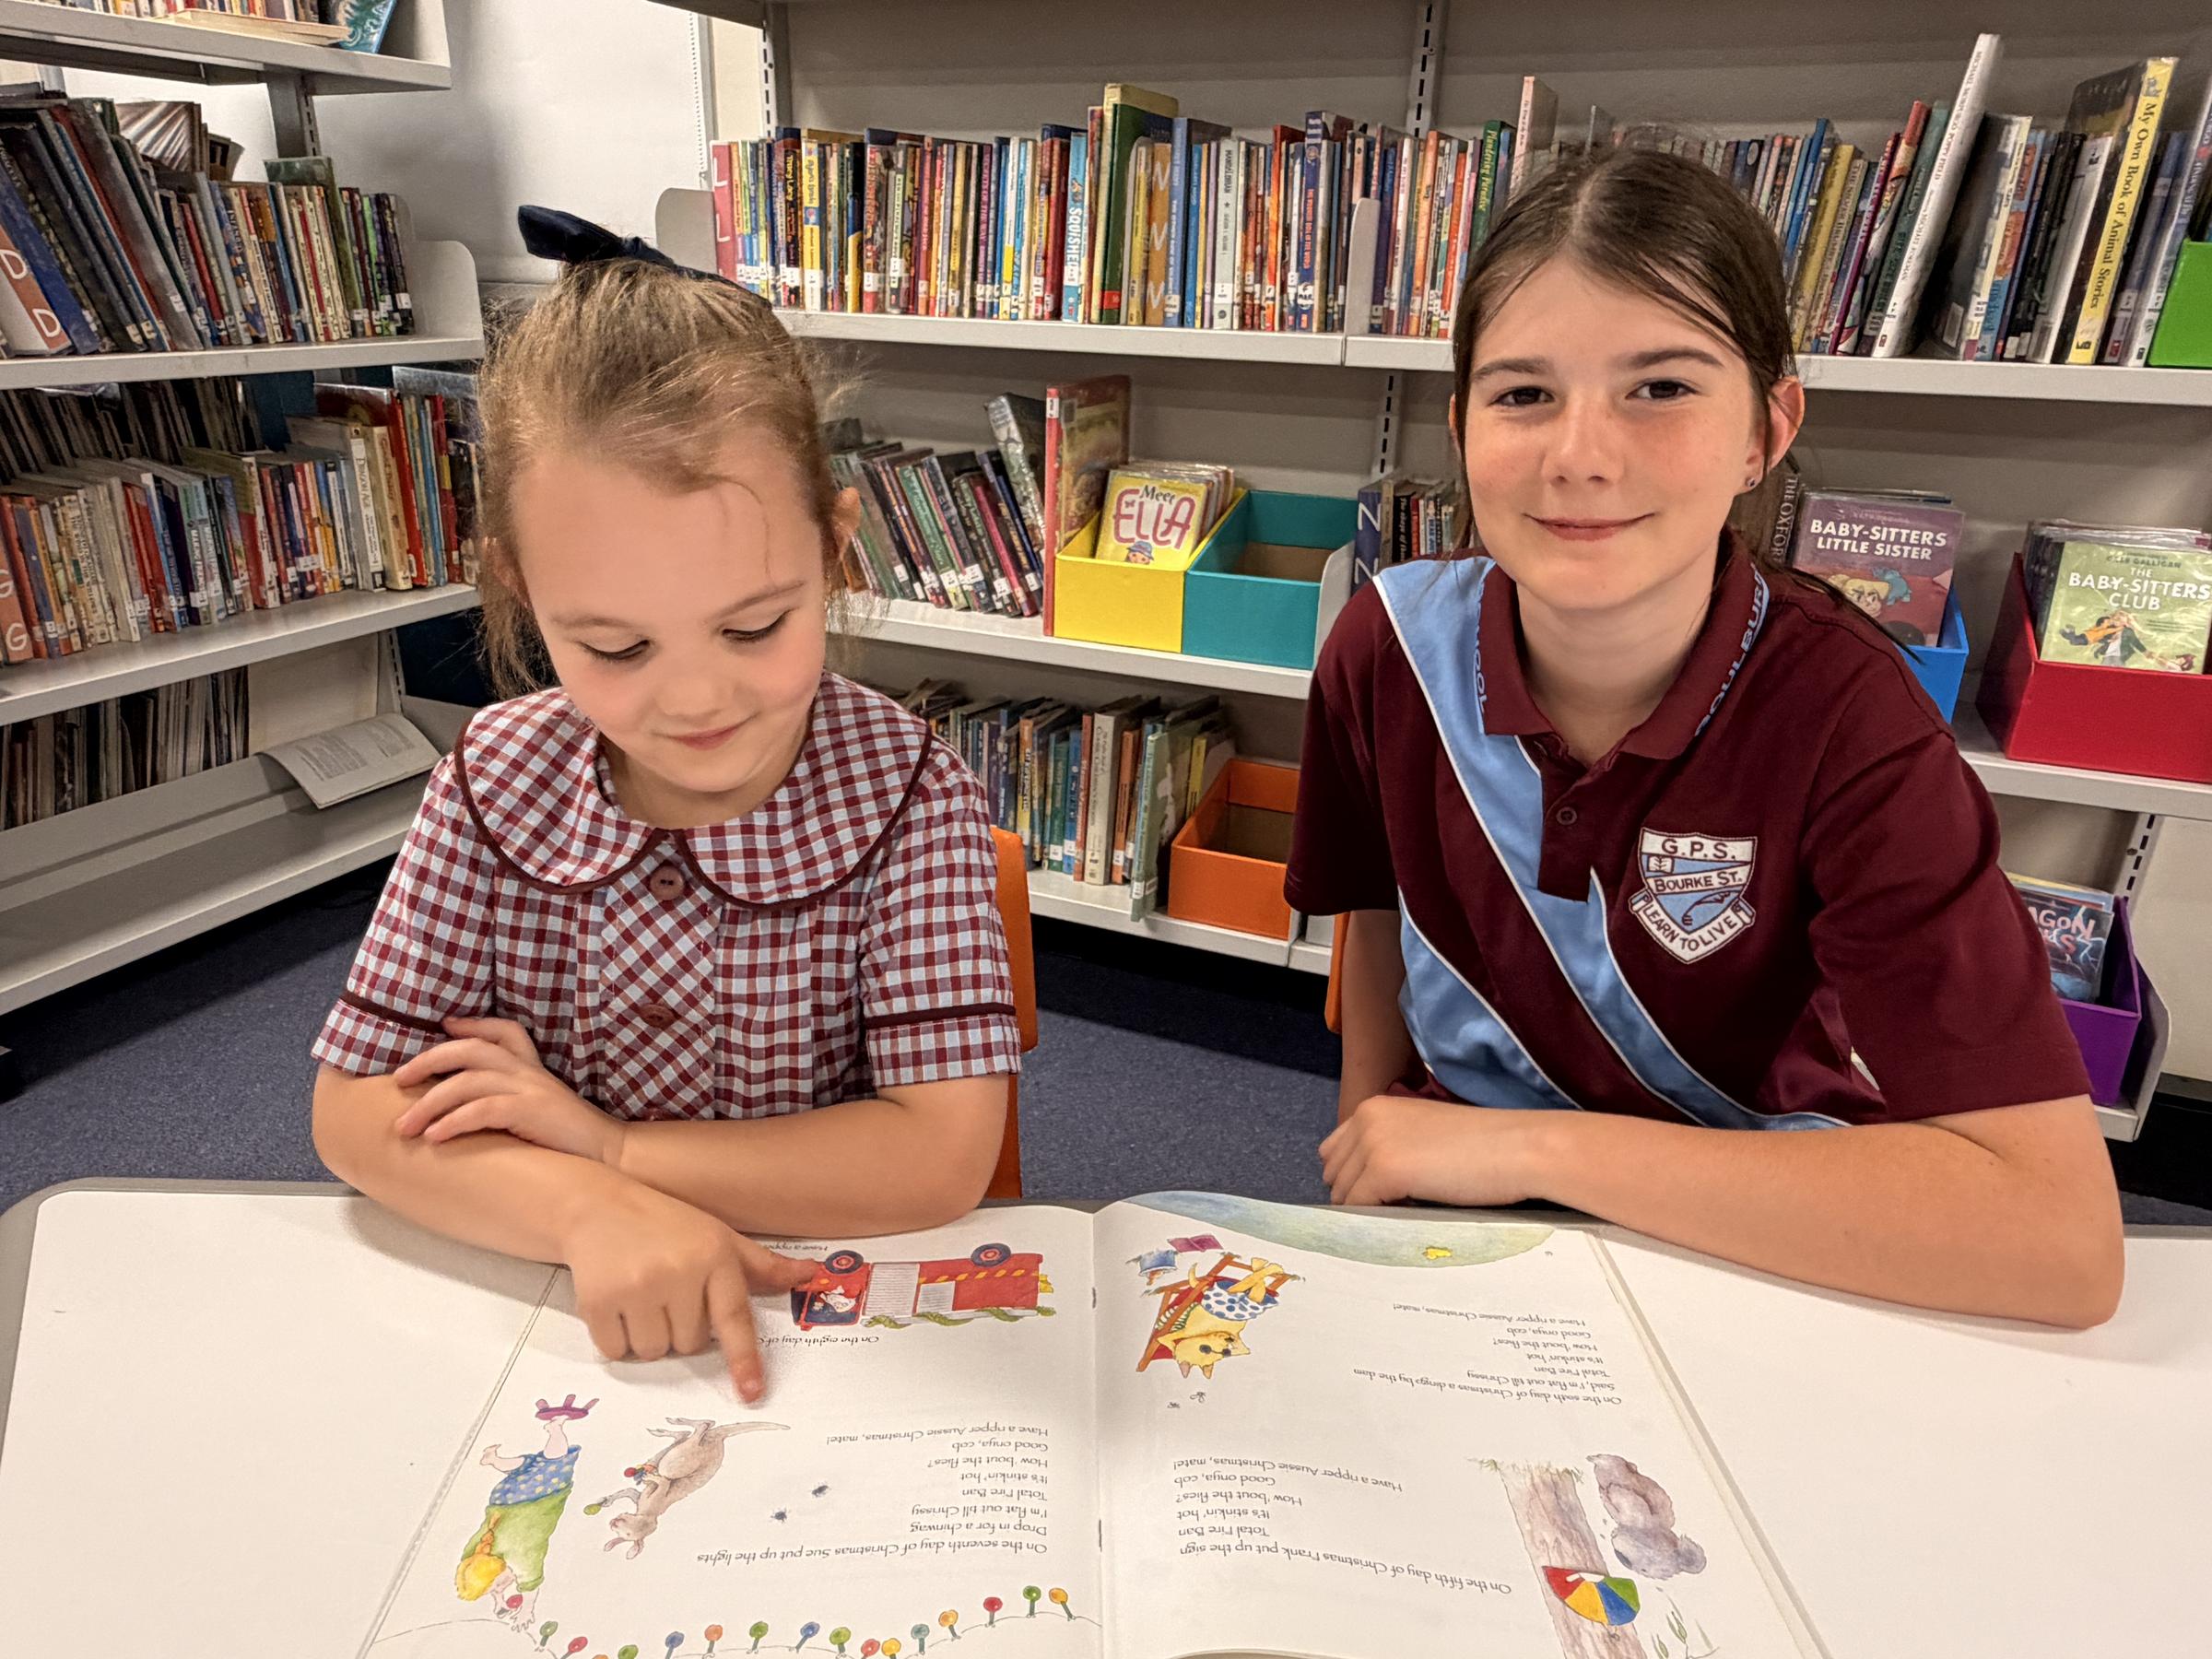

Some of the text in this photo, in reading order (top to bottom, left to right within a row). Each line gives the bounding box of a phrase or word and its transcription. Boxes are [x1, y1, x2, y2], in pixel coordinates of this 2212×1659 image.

[1941, 131, 1957, 160] POPPY
[1478, 130, 1498, 212] Plundering Paradise
[1935, 160, 1947, 181] FIELD
[2089, 102, 2157, 310] My Own Book of Animal Stories
[0, 249, 27, 279] D
[31, 308, 62, 337] D
[1785, 477, 1797, 500] THE
[1139, 485, 1175, 505] Meet
[1112, 488, 1196, 550] ELLA
[1358, 502, 1381, 532] N
[1810, 519, 1947, 547] BABY-SITTERS
[1817, 536, 1932, 560] LITTLE SISTER
[2130, 567, 2154, 578] THE
[2068, 571, 2211, 600] BABY-SITTERS
[2109, 592, 2161, 611] CLUB
[6, 622, 28, 651] G
[1661, 838, 1735, 859] G.P.S.
[1653, 876, 1712, 892] BOURKE
[1642, 904, 1737, 951] LEARN TO LIVE
[1478, 1314, 1512, 1323] Aussie
[1516, 1314, 1547, 1323] ripper
[1507, 1328, 1526, 1336] cob
[1560, 1331, 1591, 1340] Good
[1522, 1341, 1539, 1350] the
[1526, 1353, 1547, 1363] hot
[1354, 1369, 1375, 1381] dam
[1379, 1373, 1396, 1383] the
[1467, 1370, 1510, 1384] Chrissy
[1534, 1367, 1610, 1379] Total Fire Ban
[1399, 1373, 1414, 1387] by
[1416, 1377, 1446, 1392] dingo
[1512, 1378, 1524, 1386] till
[1547, 1381, 1567, 1391] flat
[1458, 1384, 1513, 1399] Christmas
[1516, 1392, 1527, 1401] of
[1529, 1389, 1550, 1403] day
[1554, 1394, 1580, 1404] sixth
[1583, 1396, 1602, 1406] the
[969, 1421, 1006, 1432] ripper
[1018, 1427, 1048, 1436] Have
[952, 1441, 975, 1453] cob
[1015, 1441, 1048, 1452] Good
[962, 1456, 982, 1467] the
[1020, 1458, 1047, 1467] How
[1278, 1464, 1318, 1476] Aussie
[1322, 1467, 1359, 1482] ripper
[960, 1473, 981, 1484] hot
[1174, 1476, 1198, 1488] cob
[1241, 1476, 1276, 1486] Good
[1371, 1478, 1402, 1492] Have
[962, 1488, 986, 1497] Ban
[1018, 1489, 1047, 1500] Total
[1213, 1491, 1233, 1502] the
[1274, 1495, 1301, 1506] How
[912, 1504, 959, 1518] Chrissy
[962, 1506, 977, 1517] till
[982, 1505, 1003, 1513] out
[1006, 1506, 1026, 1518] flat
[1177, 1510, 1199, 1522] hot
[910, 1522, 962, 1535] chinwag
[976, 1523, 995, 1535] for
[999, 1523, 1010, 1534] in
[1014, 1519, 1047, 1535] Drop
[1179, 1526, 1270, 1538] Total Fire Ban
[697, 1538, 1047, 1567] On the seventh day of Christmas Sue put up the lights
[1180, 1539, 1512, 1594] On the fifth day of Christmas Frank put up the sign
